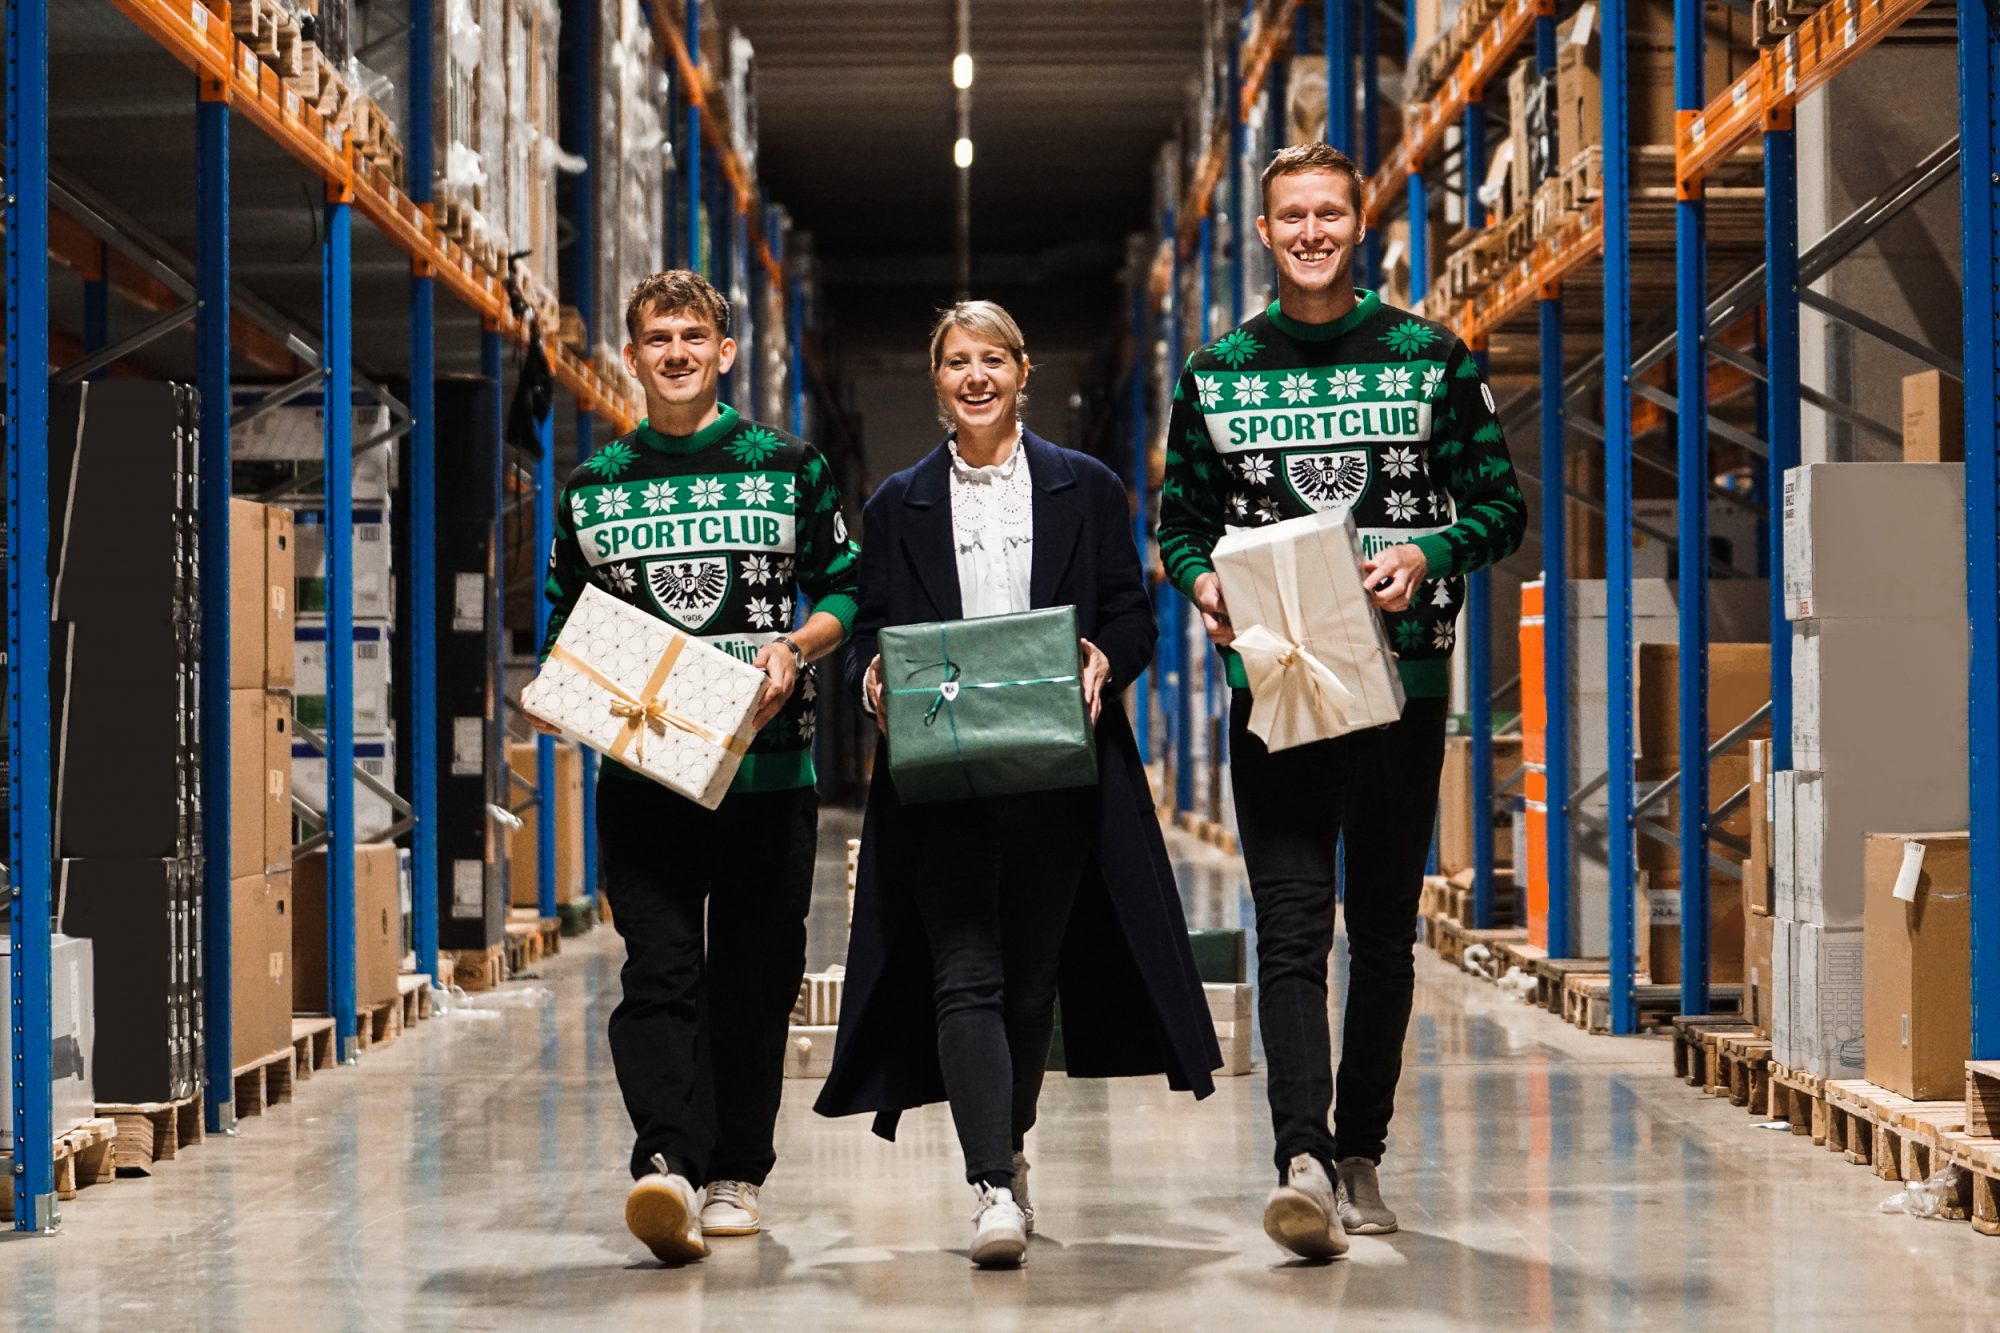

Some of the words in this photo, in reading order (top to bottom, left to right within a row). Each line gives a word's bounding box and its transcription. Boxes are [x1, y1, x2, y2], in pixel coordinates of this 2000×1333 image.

[1229, 407, 1419, 445] SPORTCLUB
[1325, 472, 1333, 482] P
[594, 516, 780, 557] SPORTCLUB
[685, 579, 693, 589] P
[682, 614, 704, 622] 1906
